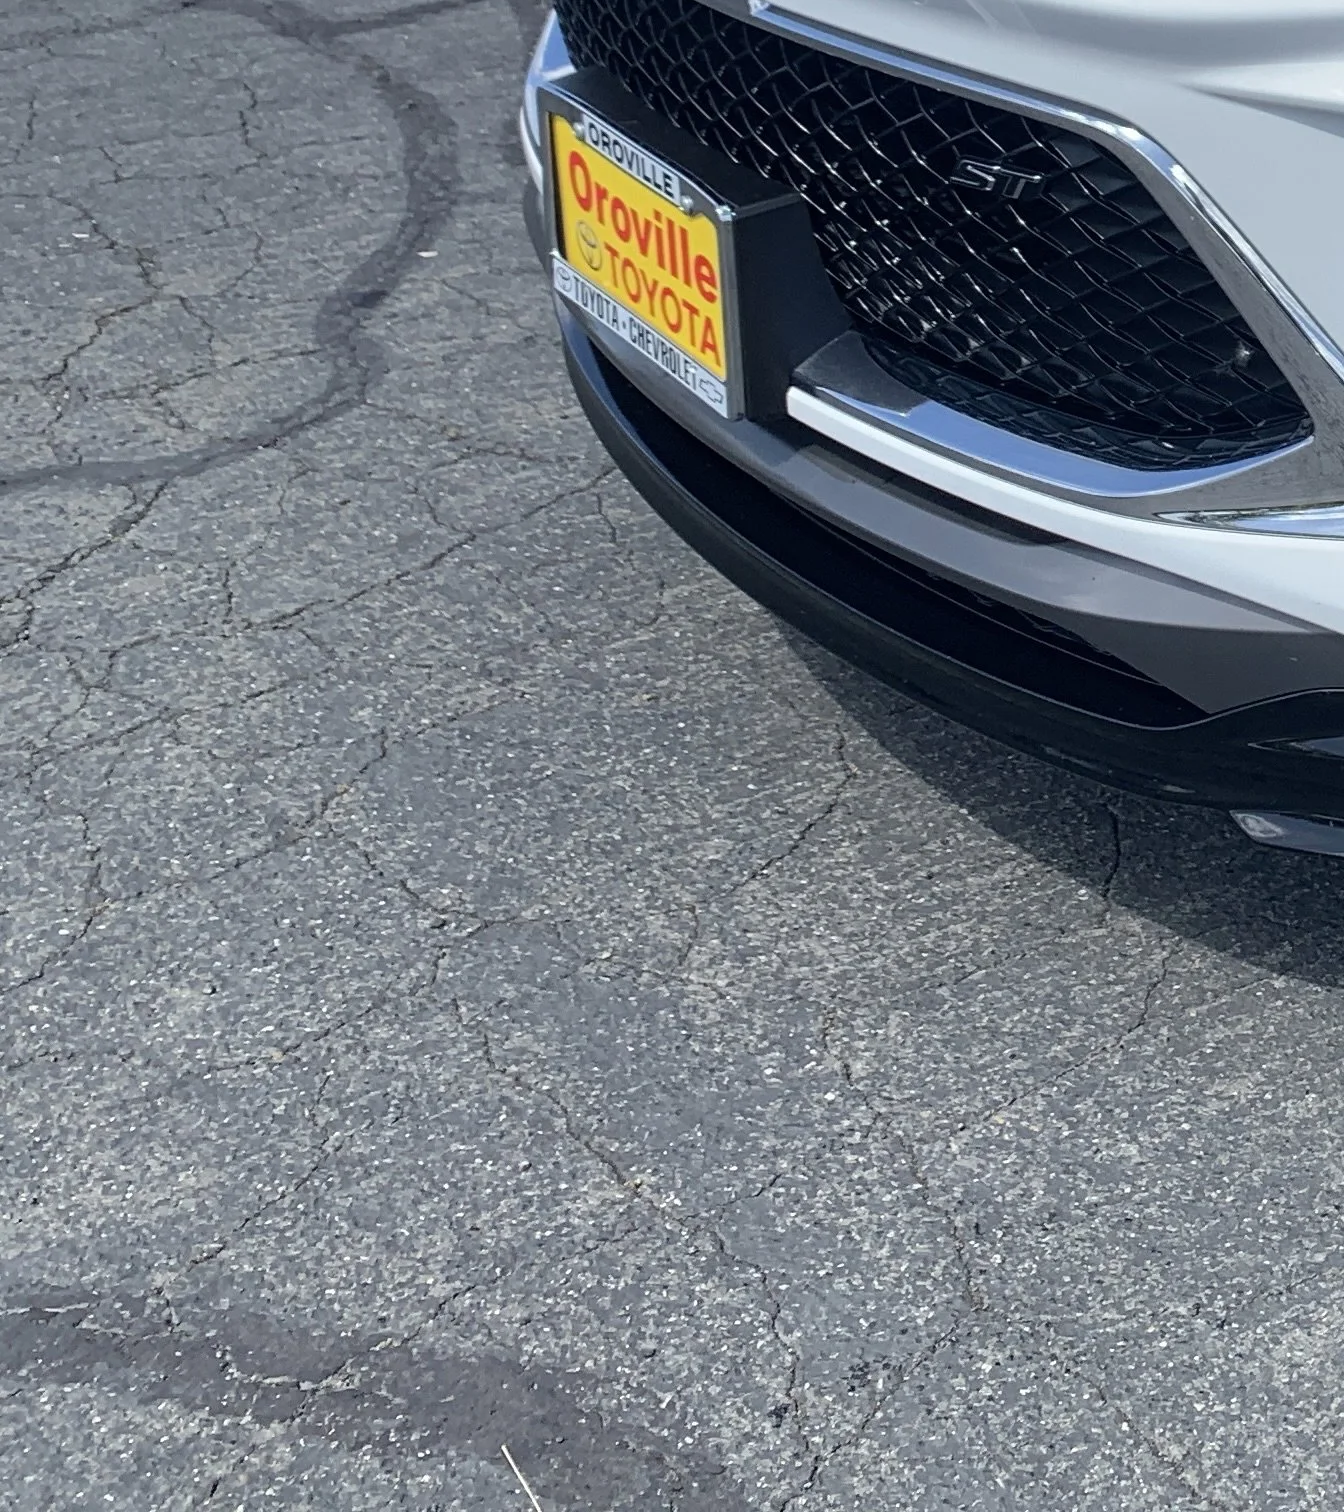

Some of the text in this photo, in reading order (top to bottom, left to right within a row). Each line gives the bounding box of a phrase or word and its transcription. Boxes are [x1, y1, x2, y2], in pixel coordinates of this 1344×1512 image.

[588, 121, 675, 198] OROVILLE
[949, 154, 1046, 200] ST
[568, 150, 718, 304] Oroville
[572, 275, 698, 388] TOYOTA CHEVROLET
[604, 240, 722, 369] TOYOTA
